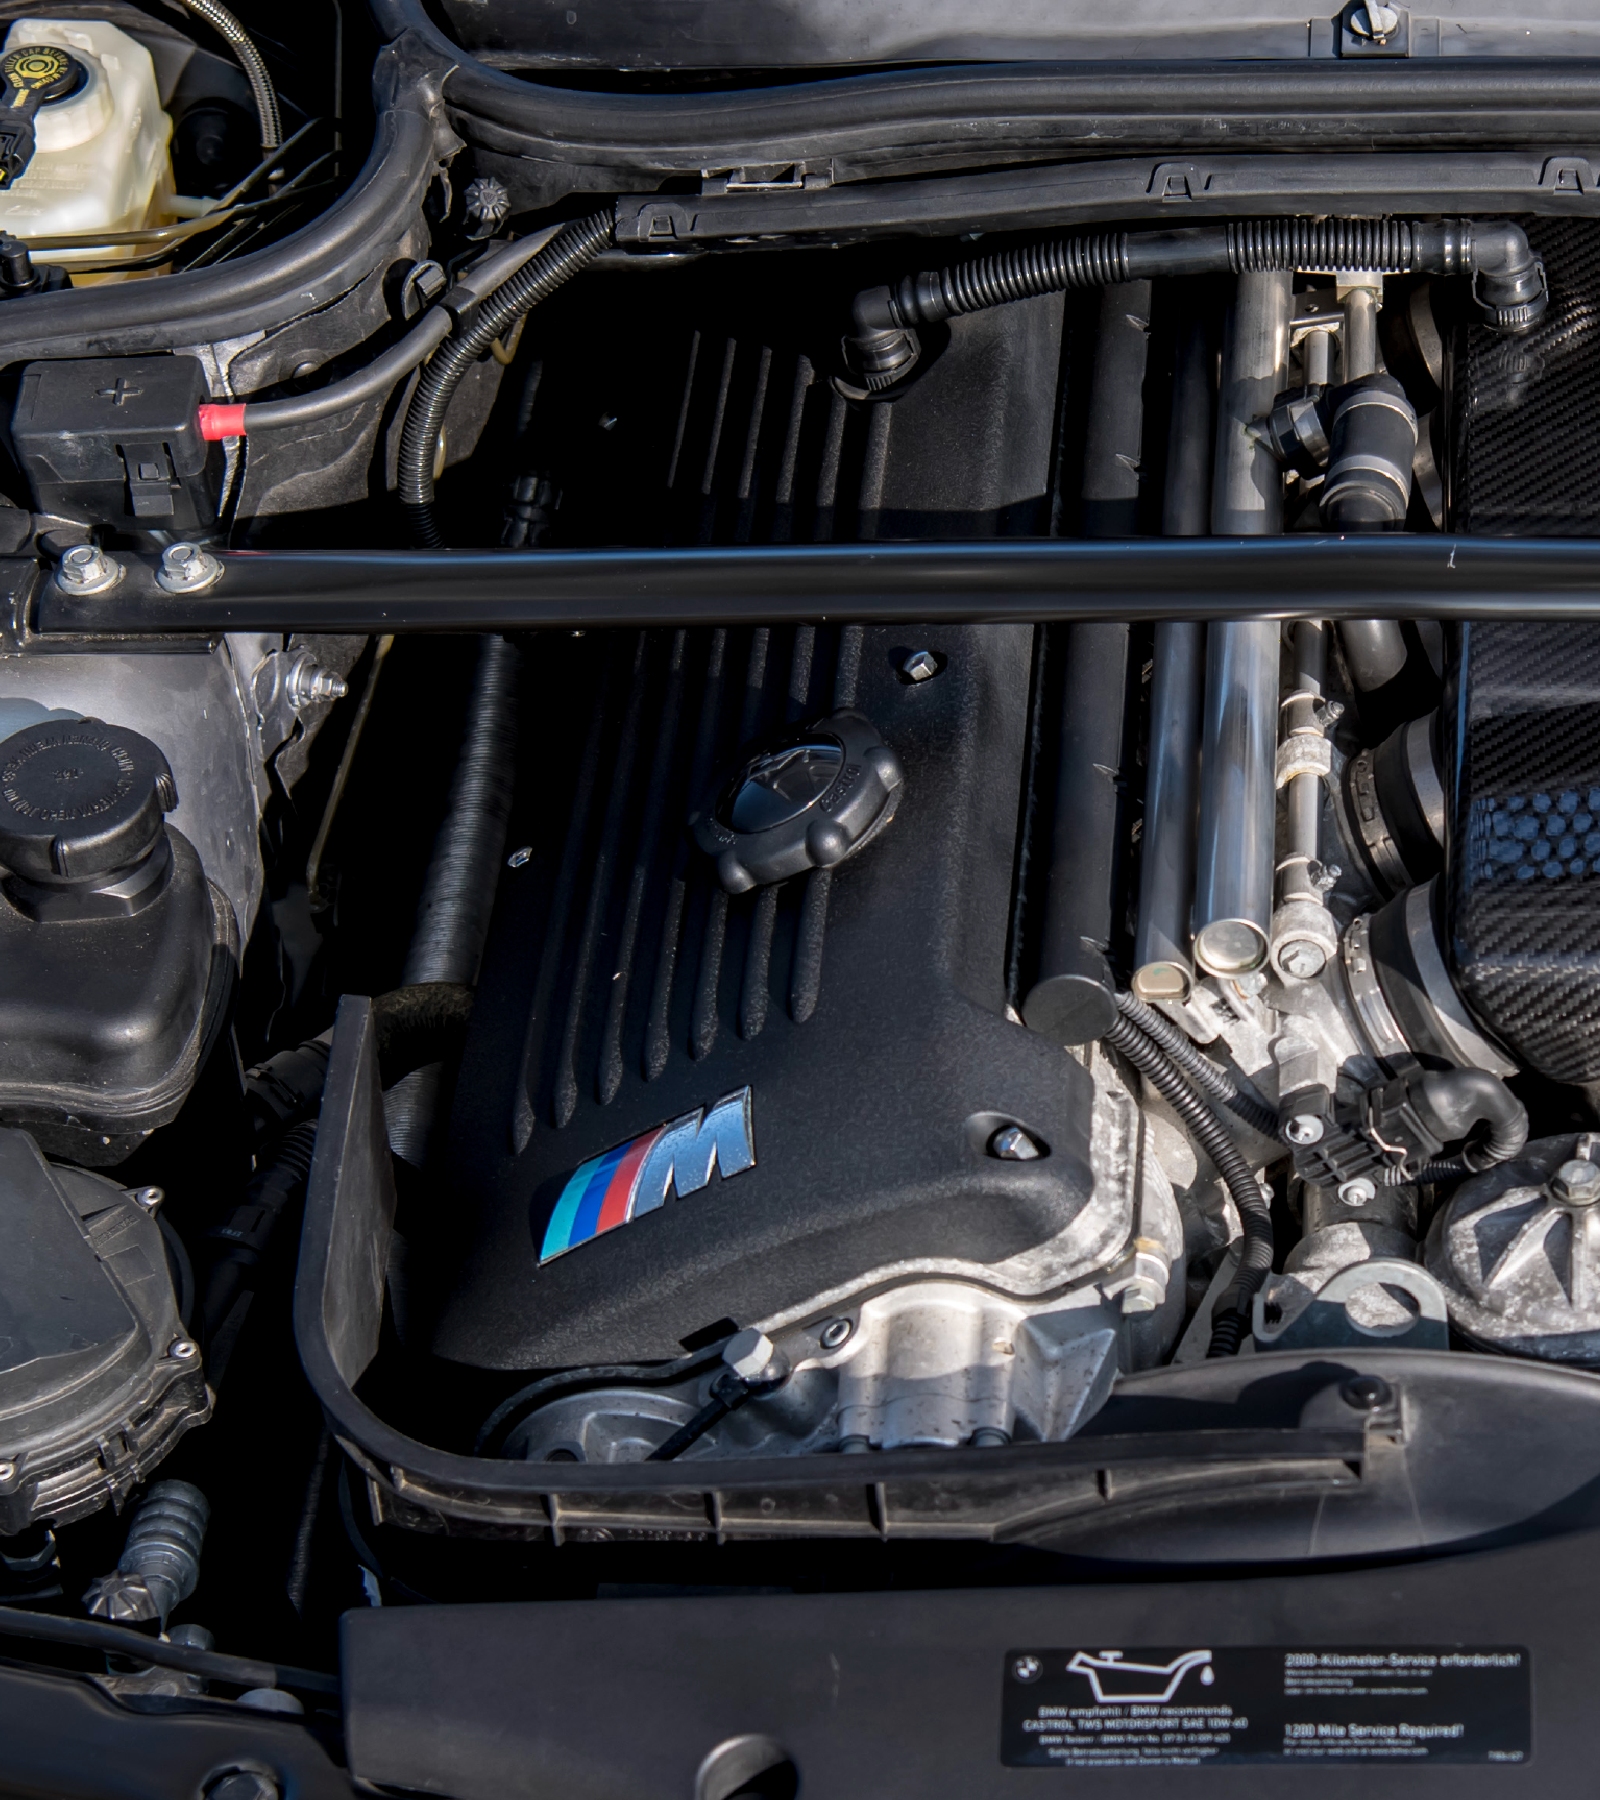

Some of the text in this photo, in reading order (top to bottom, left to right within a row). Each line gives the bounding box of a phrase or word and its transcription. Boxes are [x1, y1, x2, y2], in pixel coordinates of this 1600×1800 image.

[819, 764, 862, 813] Castrol
[1038, 1705, 1068, 1718] BMW
[1130, 1705, 1160, 1717] BMW
[1023, 1719, 1075, 1732] CASTROL
[1078, 1719, 1103, 1731] TWS
[1104, 1718, 1179, 1731] MOTORSPORT
[1182, 1718, 1205, 1730] SAE
[1285, 1723, 1464, 1739] 1200 Mile Service Required!
